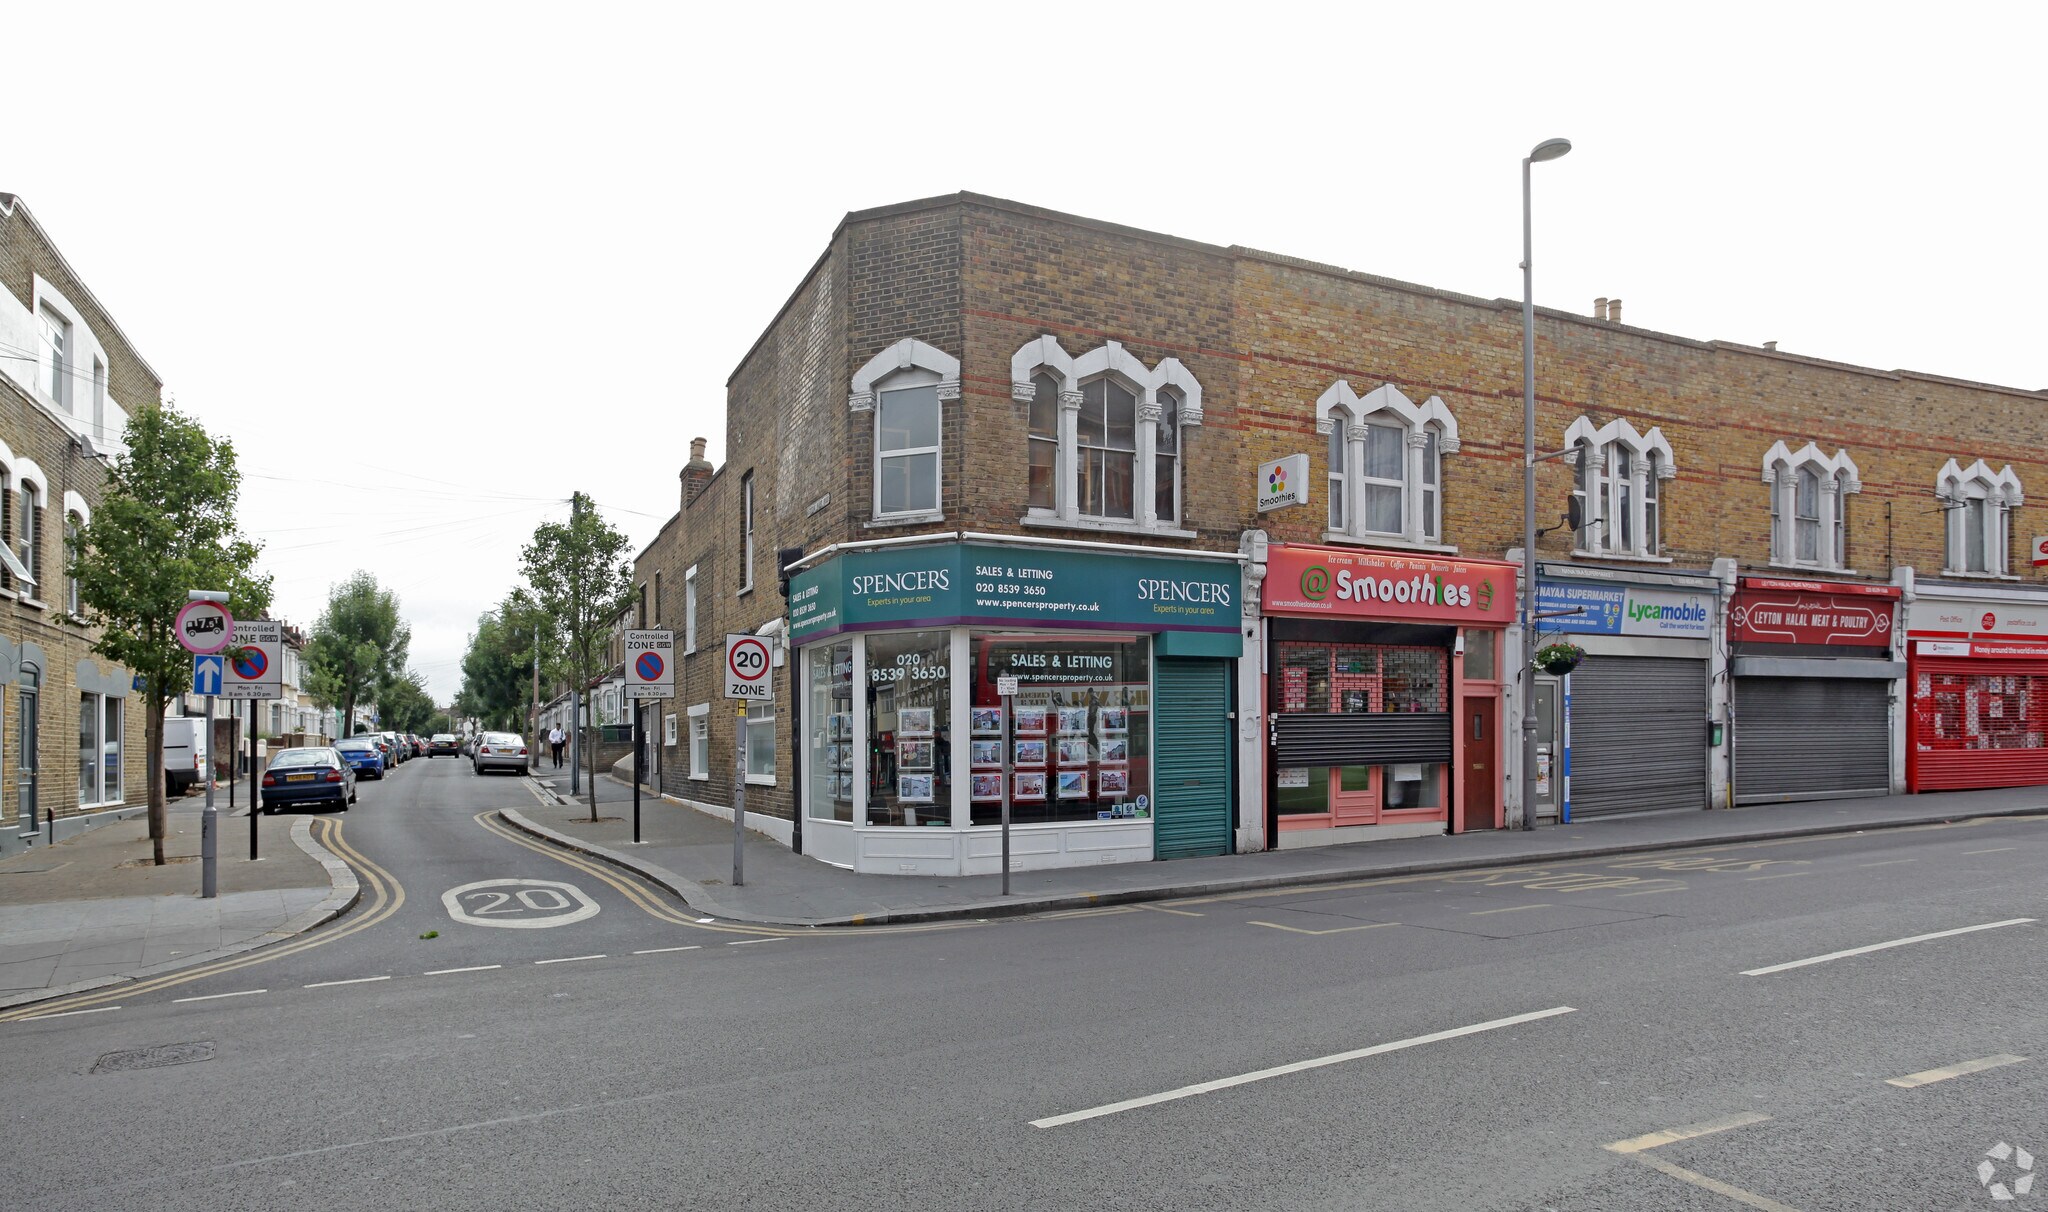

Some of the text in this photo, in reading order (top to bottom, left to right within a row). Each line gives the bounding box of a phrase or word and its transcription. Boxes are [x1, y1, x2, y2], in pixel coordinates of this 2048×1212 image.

[1260, 492, 1295, 507] Smoothies
[1328, 555, 1467, 573] Ice cream Milkshakes Coffee Paninis Desserts Juices
[976, 566, 1053, 580] SALES & LETTING
[853, 569, 949, 595] SPENCERS
[1301, 565, 1471, 607] @ Smoothies
[793, 590, 802, 603] SALES
[805, 585, 819, 599] LETTING
[976, 583, 1046, 596] 020 8539 3650
[1138, 578, 1230, 607] SPENCERS
[1567, 589, 1624, 602] SUPERMARKET
[867, 597, 891, 607] Experts
[899, 597, 914, 606] your
[916, 595, 931, 603] area
[976, 599, 1100, 613] www.spencersproperty.co.uk
[1272, 600, 1332, 609] www.smoothieslondon.co.uk
[799, 605, 807, 615] 8539
[807, 602, 816, 613] 3650
[1153, 603, 1215, 616] Experts in your area
[1628, 599, 1706, 622] Lycamobile
[793, 607, 837, 629] www.spencersproperty.co.uk
[1755, 611, 1782, 625] LEYTON
[1785, 613, 1807, 626] HALAL
[1811, 614, 1830, 627] MEAT
[1832, 615, 1837, 627] &
[1840, 616, 1868, 628] POULTRY
[1940, 615, 1962, 624] Post Office
[233, 624, 275, 632] ontrolled
[231, 634, 257, 643] ONE
[1974, 646, 1990, 654] Money
[2016, 647, 2030, 655] world
[737, 651, 762, 668] 20
[896, 654, 920, 666] 020
[1011, 653, 1112, 669] SALES & LETTING
[813, 667, 826, 679] SALES
[833, 661, 852, 676] LETTING
[872, 666, 946, 681] 8539 3650
[1011, 673, 1113, 682] www.spencersproperty.co.uk
[732, 684, 765, 696] ZONE
[465, 889, 571, 915] 20
